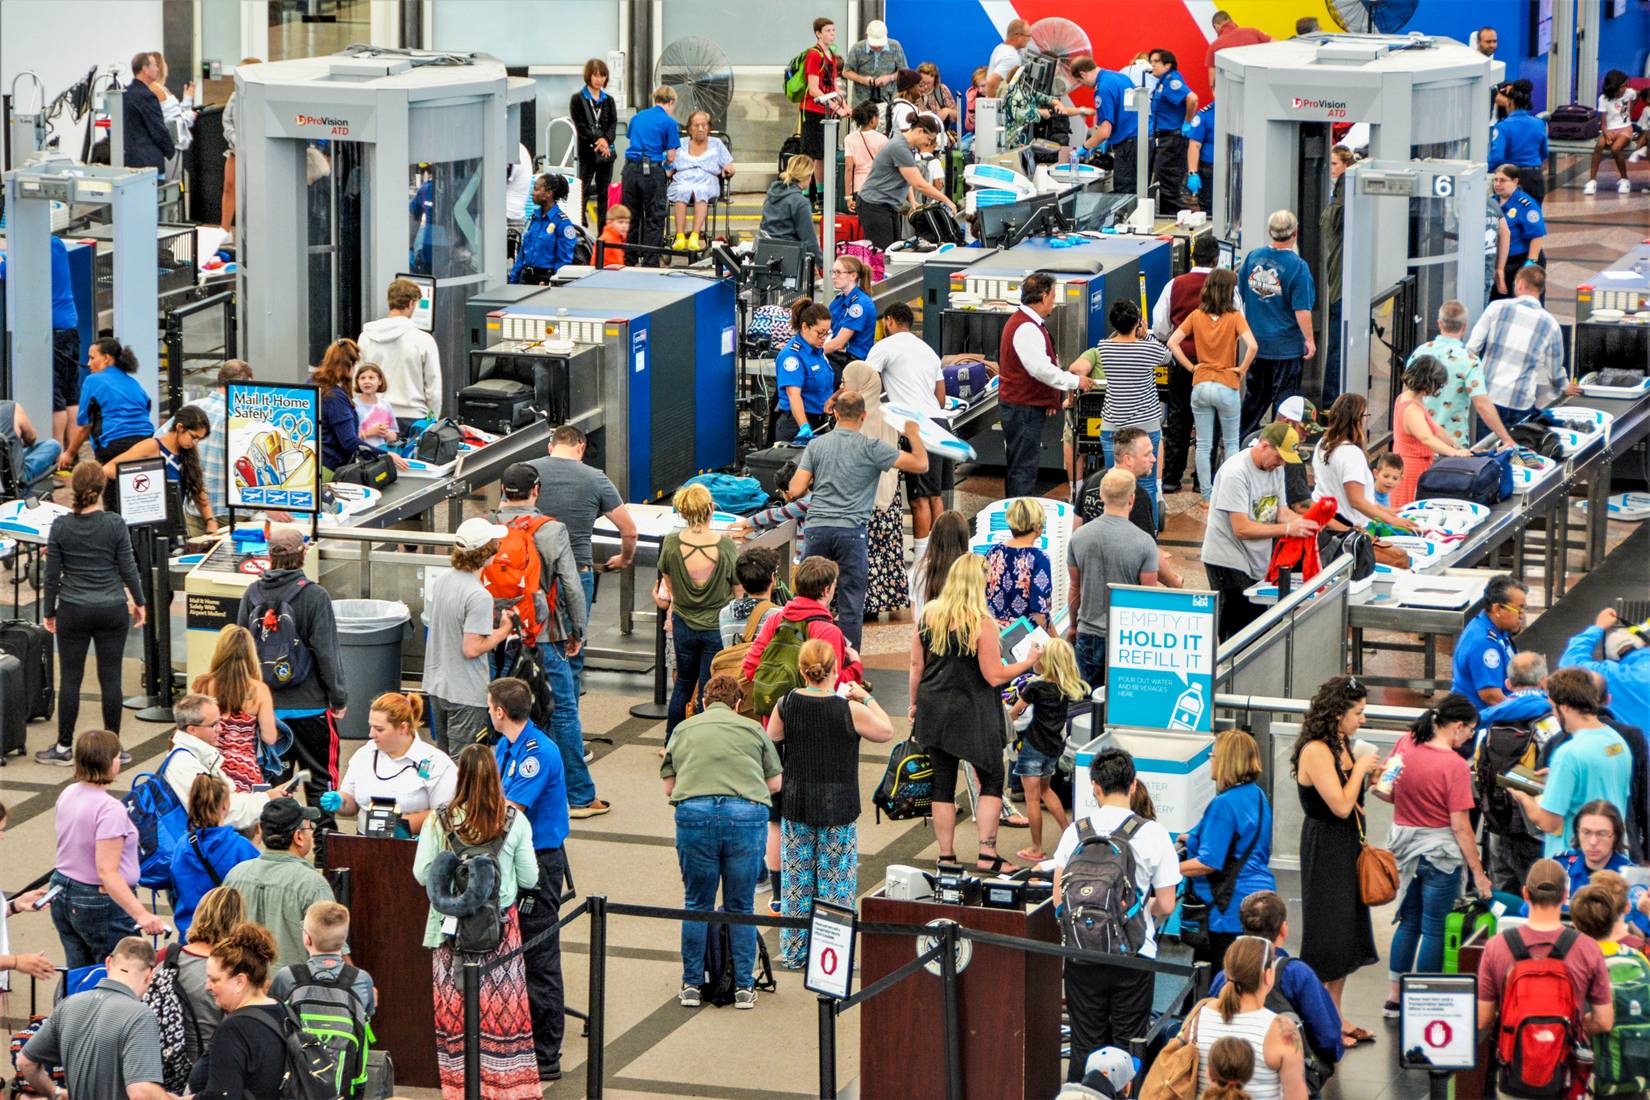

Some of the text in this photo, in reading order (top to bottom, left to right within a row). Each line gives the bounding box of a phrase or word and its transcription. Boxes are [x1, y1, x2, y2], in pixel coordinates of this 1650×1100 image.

[1303, 99, 1347, 109] ProVision
[307, 116, 349, 126] ProVision
[1327, 109, 1347, 118] ATD
[331, 127, 350, 136] ATD
[1435, 175, 1452, 197] 6
[233, 392, 310, 409] Mail It Home
[234, 406, 273, 423] Safely!
[1119, 610, 1203, 631] EMPTY IT
[1119, 629, 1203, 651] HOLD IT
[1118, 649, 1202, 669] REFILL IT
[1146, 781, 1169, 791] ATER
